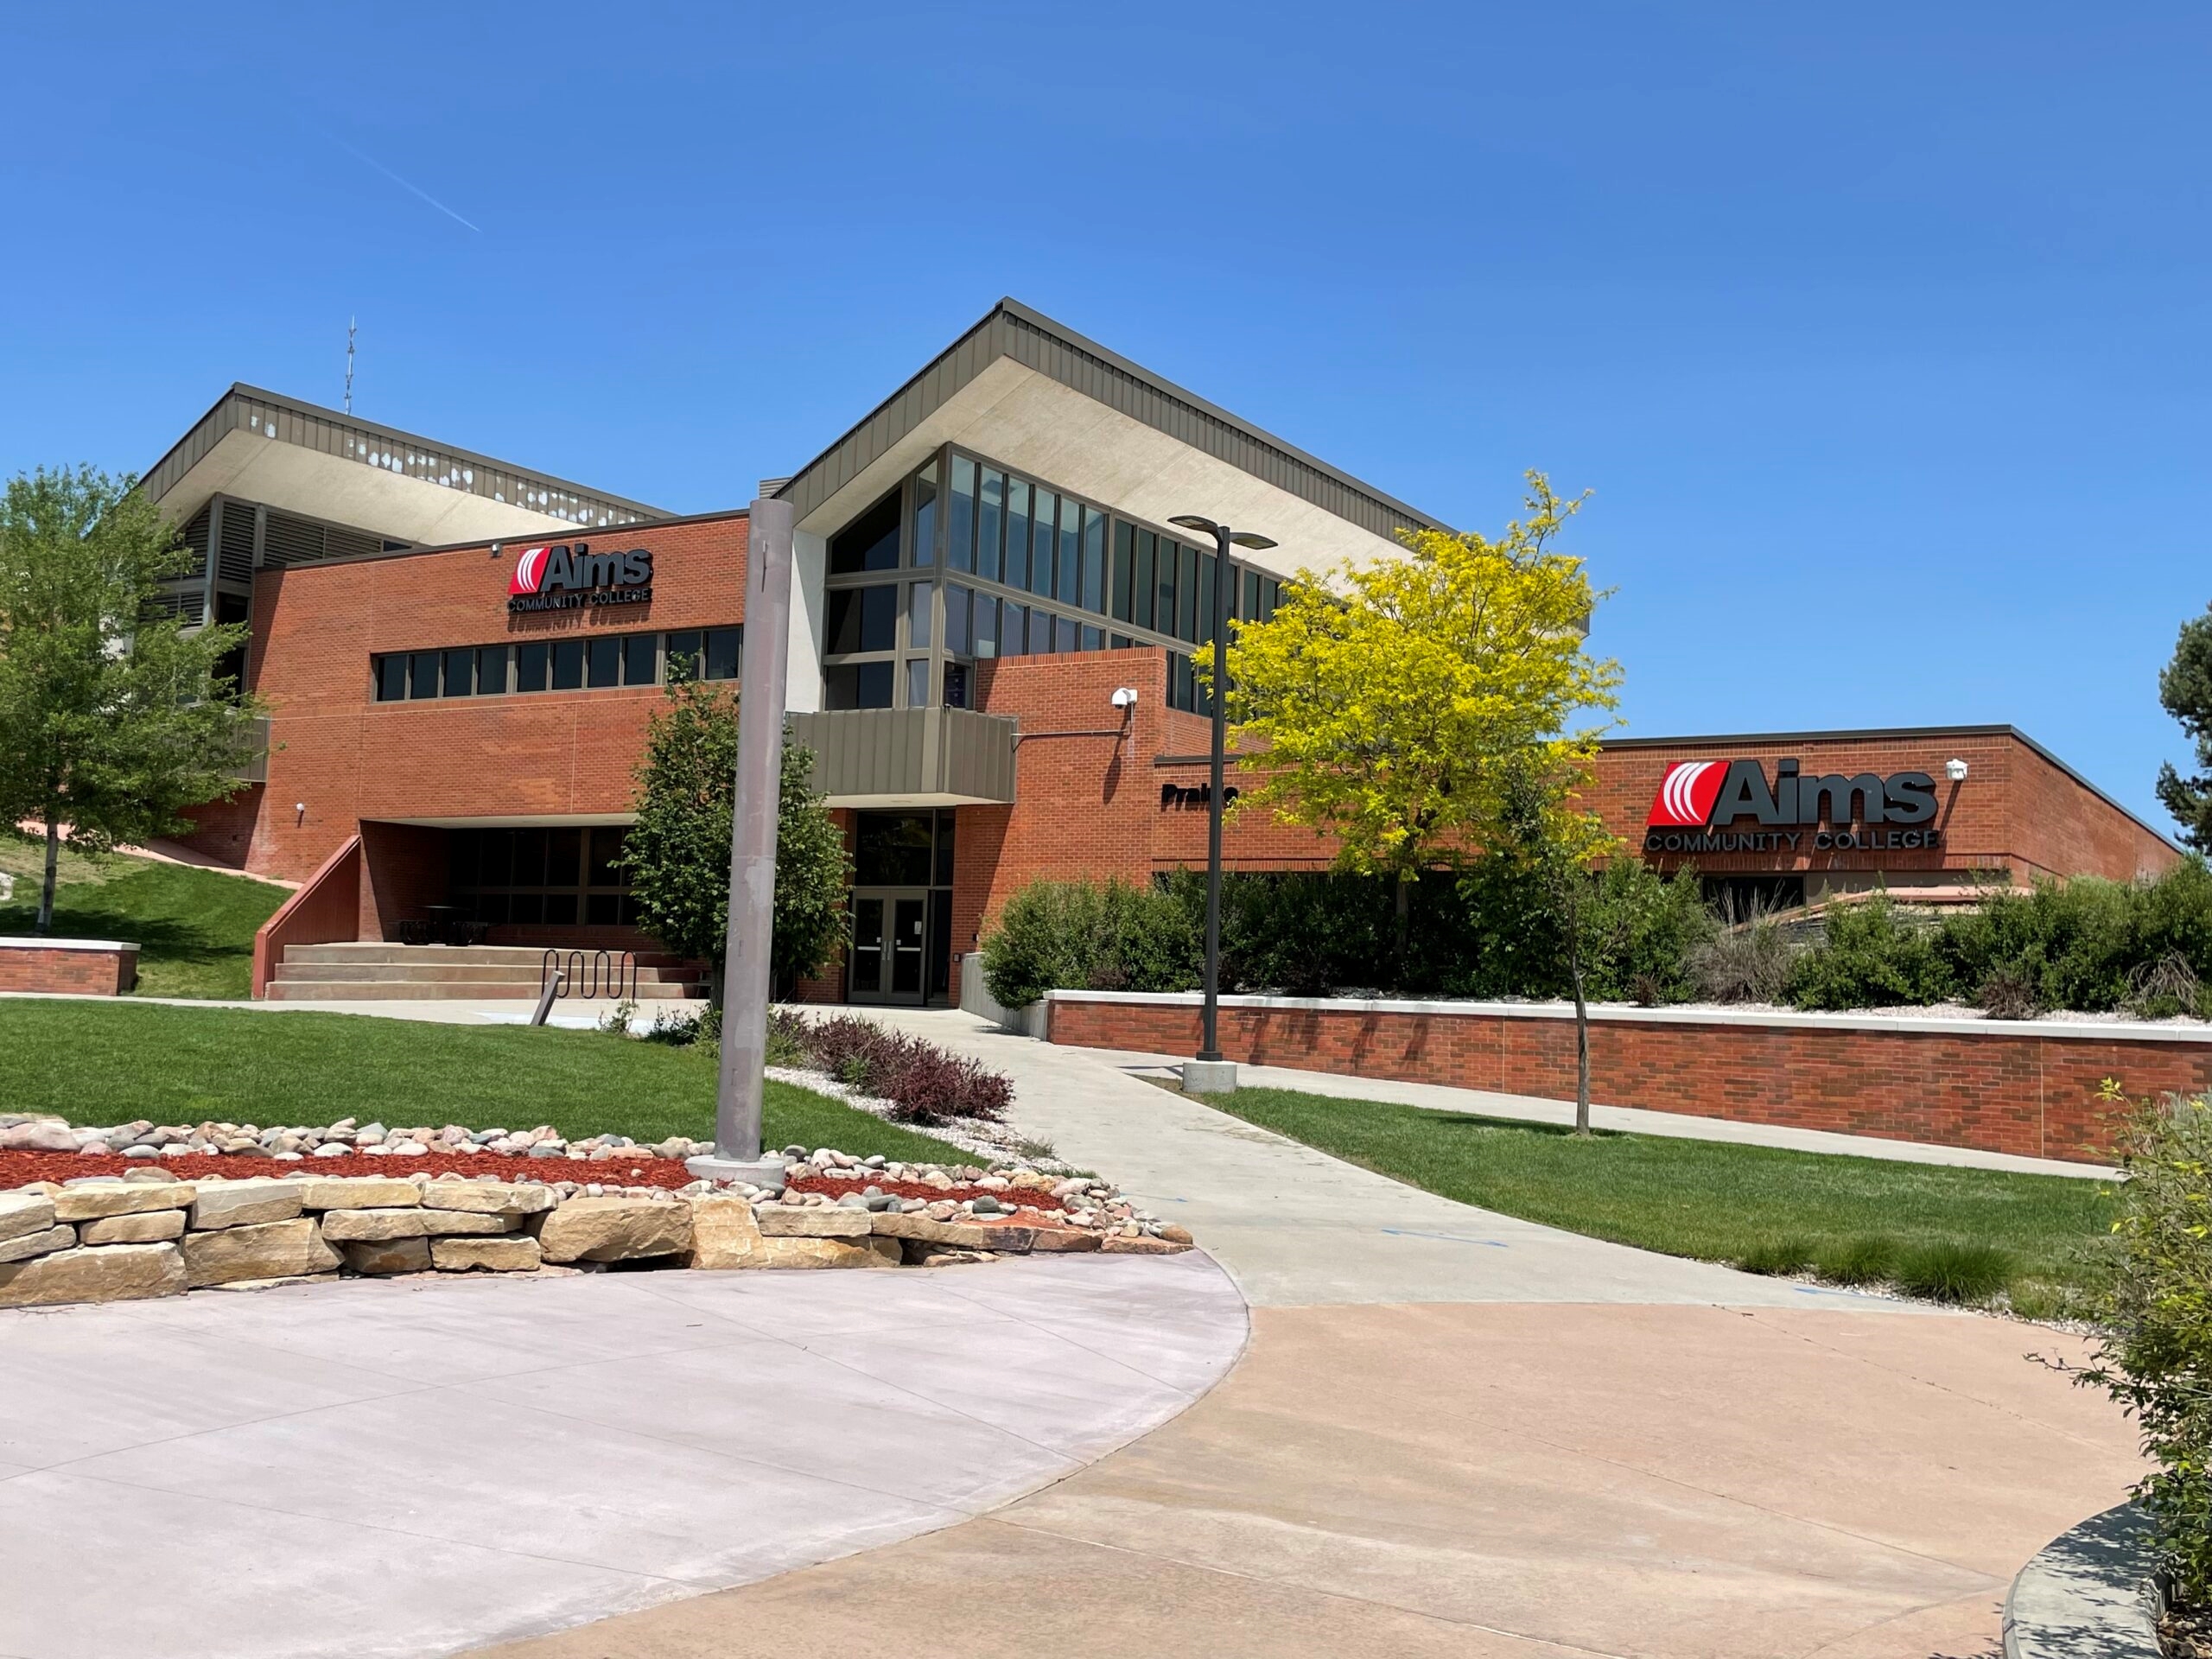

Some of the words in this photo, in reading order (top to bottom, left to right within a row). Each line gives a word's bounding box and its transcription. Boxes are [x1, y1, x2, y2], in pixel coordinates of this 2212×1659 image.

[540, 543, 653, 592] Aims
[508, 594, 583, 613] COMMUNITY
[590, 589, 651, 606] COLLEGE
[1161, 783, 1238, 804] Praie
[1712, 759, 1939, 825] Aims
[1645, 832, 1802, 852] COMMUNITY
[1815, 830, 1940, 850] COLLEGE
